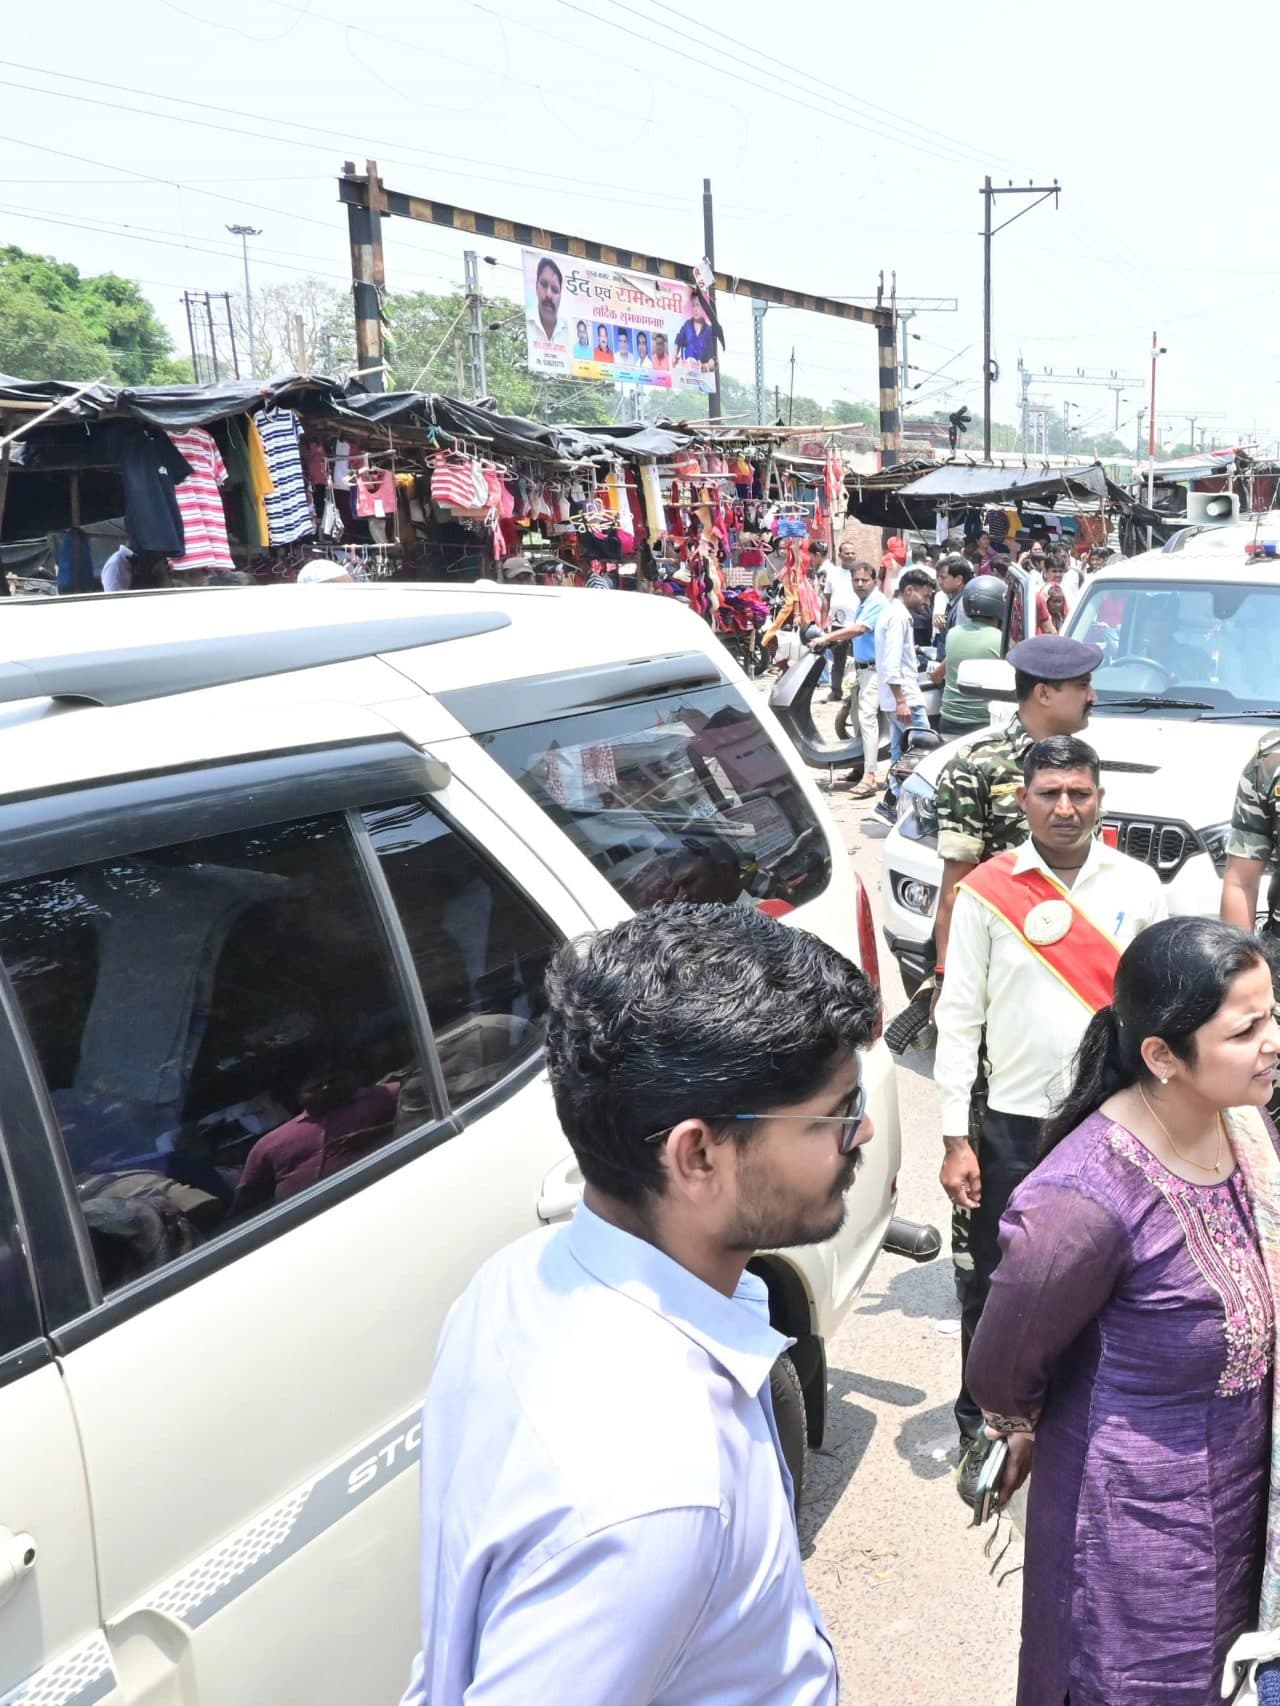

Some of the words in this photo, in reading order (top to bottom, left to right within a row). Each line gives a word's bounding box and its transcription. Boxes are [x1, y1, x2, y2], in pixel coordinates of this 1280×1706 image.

[565, 270, 592, 298] ईद
[595, 284, 613, 302] एवं
[592, 304, 618, 320] हार्दिक
